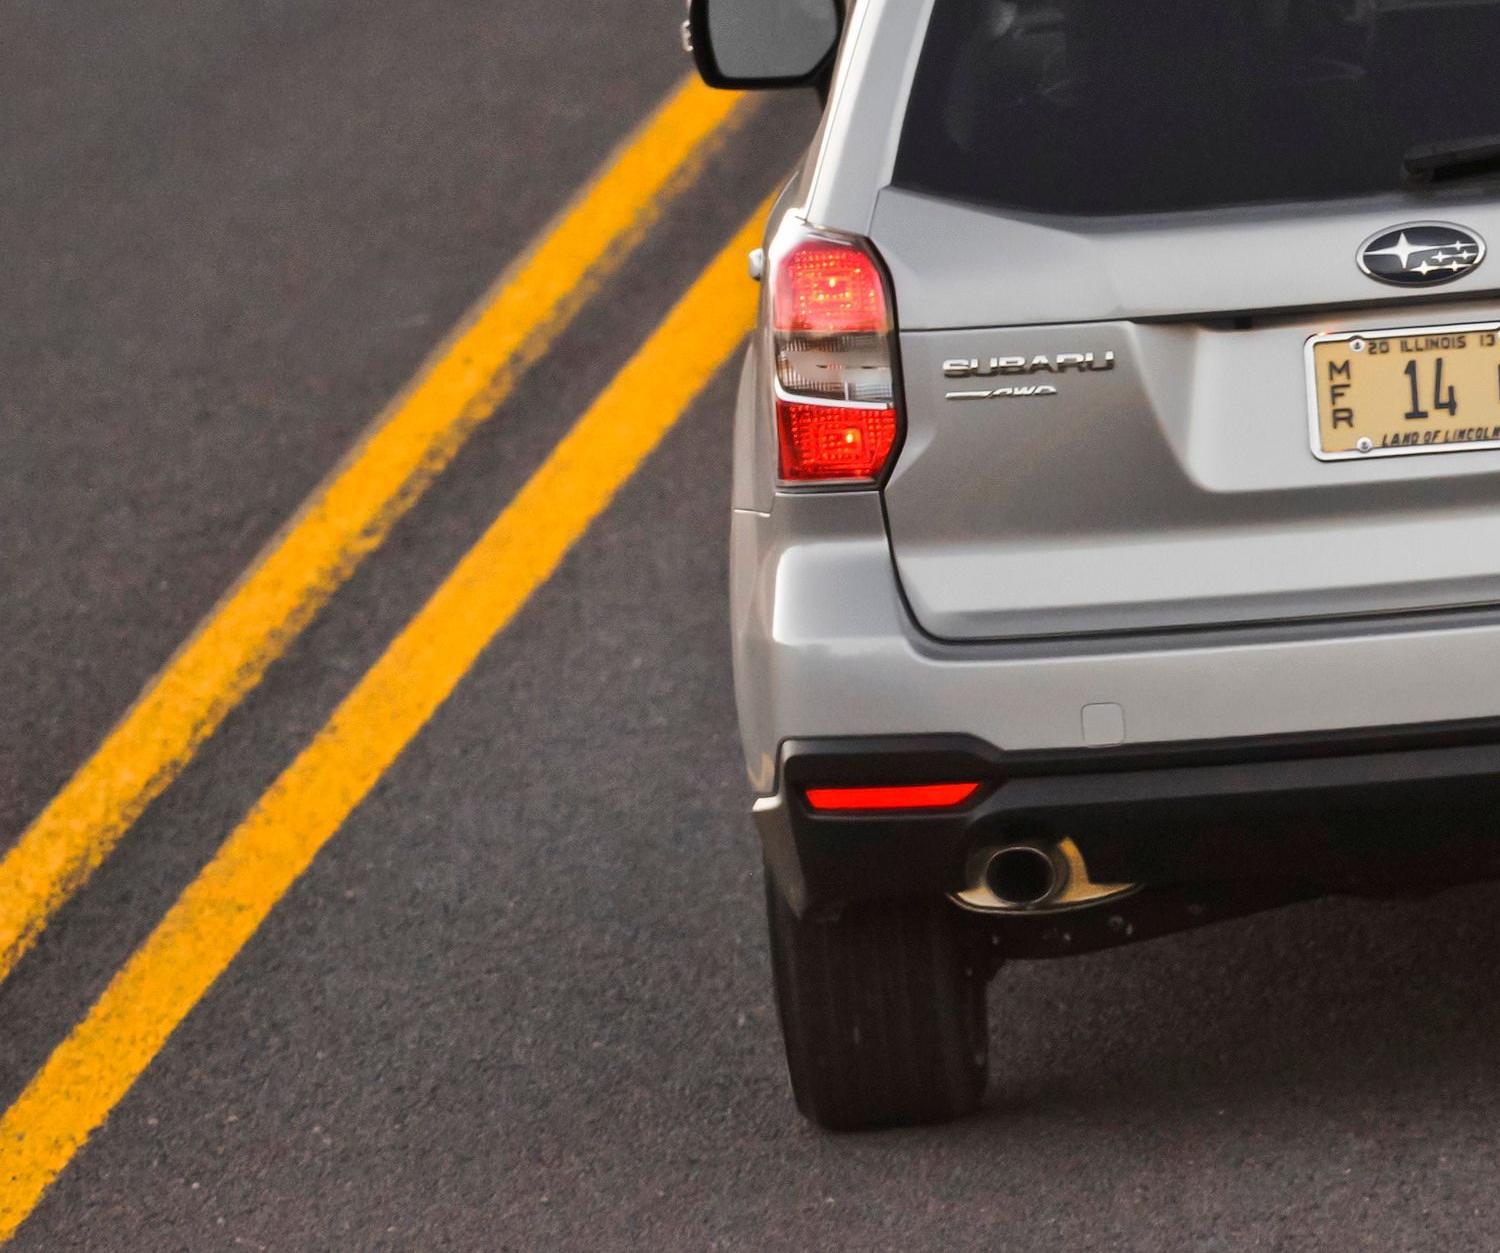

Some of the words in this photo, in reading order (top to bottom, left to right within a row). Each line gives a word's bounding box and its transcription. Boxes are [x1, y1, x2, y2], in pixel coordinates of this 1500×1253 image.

[1400, 335, 1467, 353] ILLINOIS
[942, 350, 1115, 378] SUBARU
[988, 385, 1058, 398] AWD
[1403, 357, 1458, 420] 14
[1382, 431, 1420, 447] LAND
[1424, 430, 1442, 443] OF
